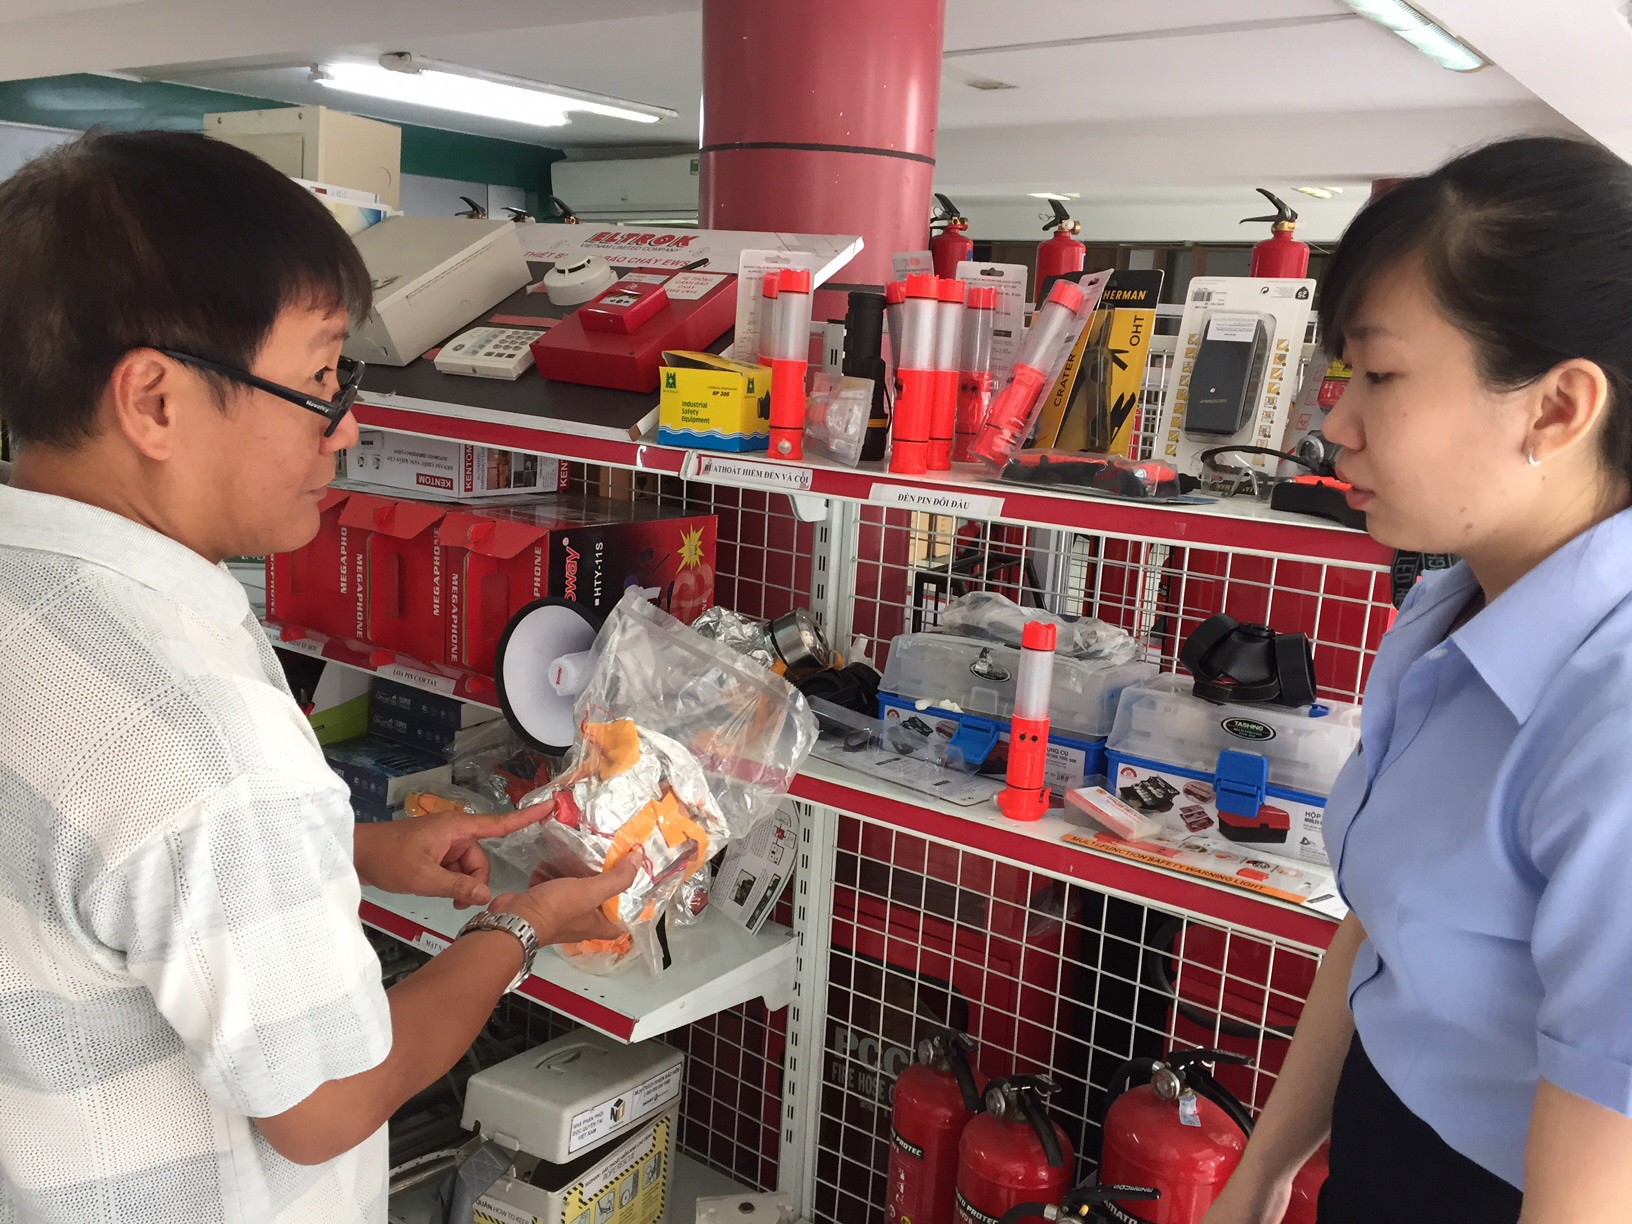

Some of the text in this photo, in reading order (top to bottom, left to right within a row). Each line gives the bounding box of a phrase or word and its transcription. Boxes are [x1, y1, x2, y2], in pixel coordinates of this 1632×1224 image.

[585, 231, 700, 248] ELTROK
[1103, 290, 1147, 301] HERMAN
[1129, 315, 1144, 347] OHT
[1053, 353, 1076, 407] CRATER
[681, 400, 708, 409] Industrial
[681, 408, 699, 416] Safety
[681, 415, 711, 424] Equipment
[419, 475, 452, 488] KENTOM
[465, 444, 473, 489] KENTOM
[897, 492, 916, 503] ĐÈN
[917, 495, 931, 505] PIN
[340, 526, 348, 594] MEGAPHO
[533, 546, 542, 597] PHONE
[565, 546, 580, 602] oway
[594, 541, 604, 597] HTY-11S
[451, 573, 459, 663] MEGAPHONE
[1070, 835, 1267, 891] MULTI-FUNCTION SAFETY WARNING LIGHT
[834, 1026, 910, 1080] PCC
[831, 1061, 856, 1088] FIRE
[858, 1071, 886, 1100] HOSE
[895, 1136, 922, 1157] PROTEC
[1102, 1199, 1139, 1224] AMATO
